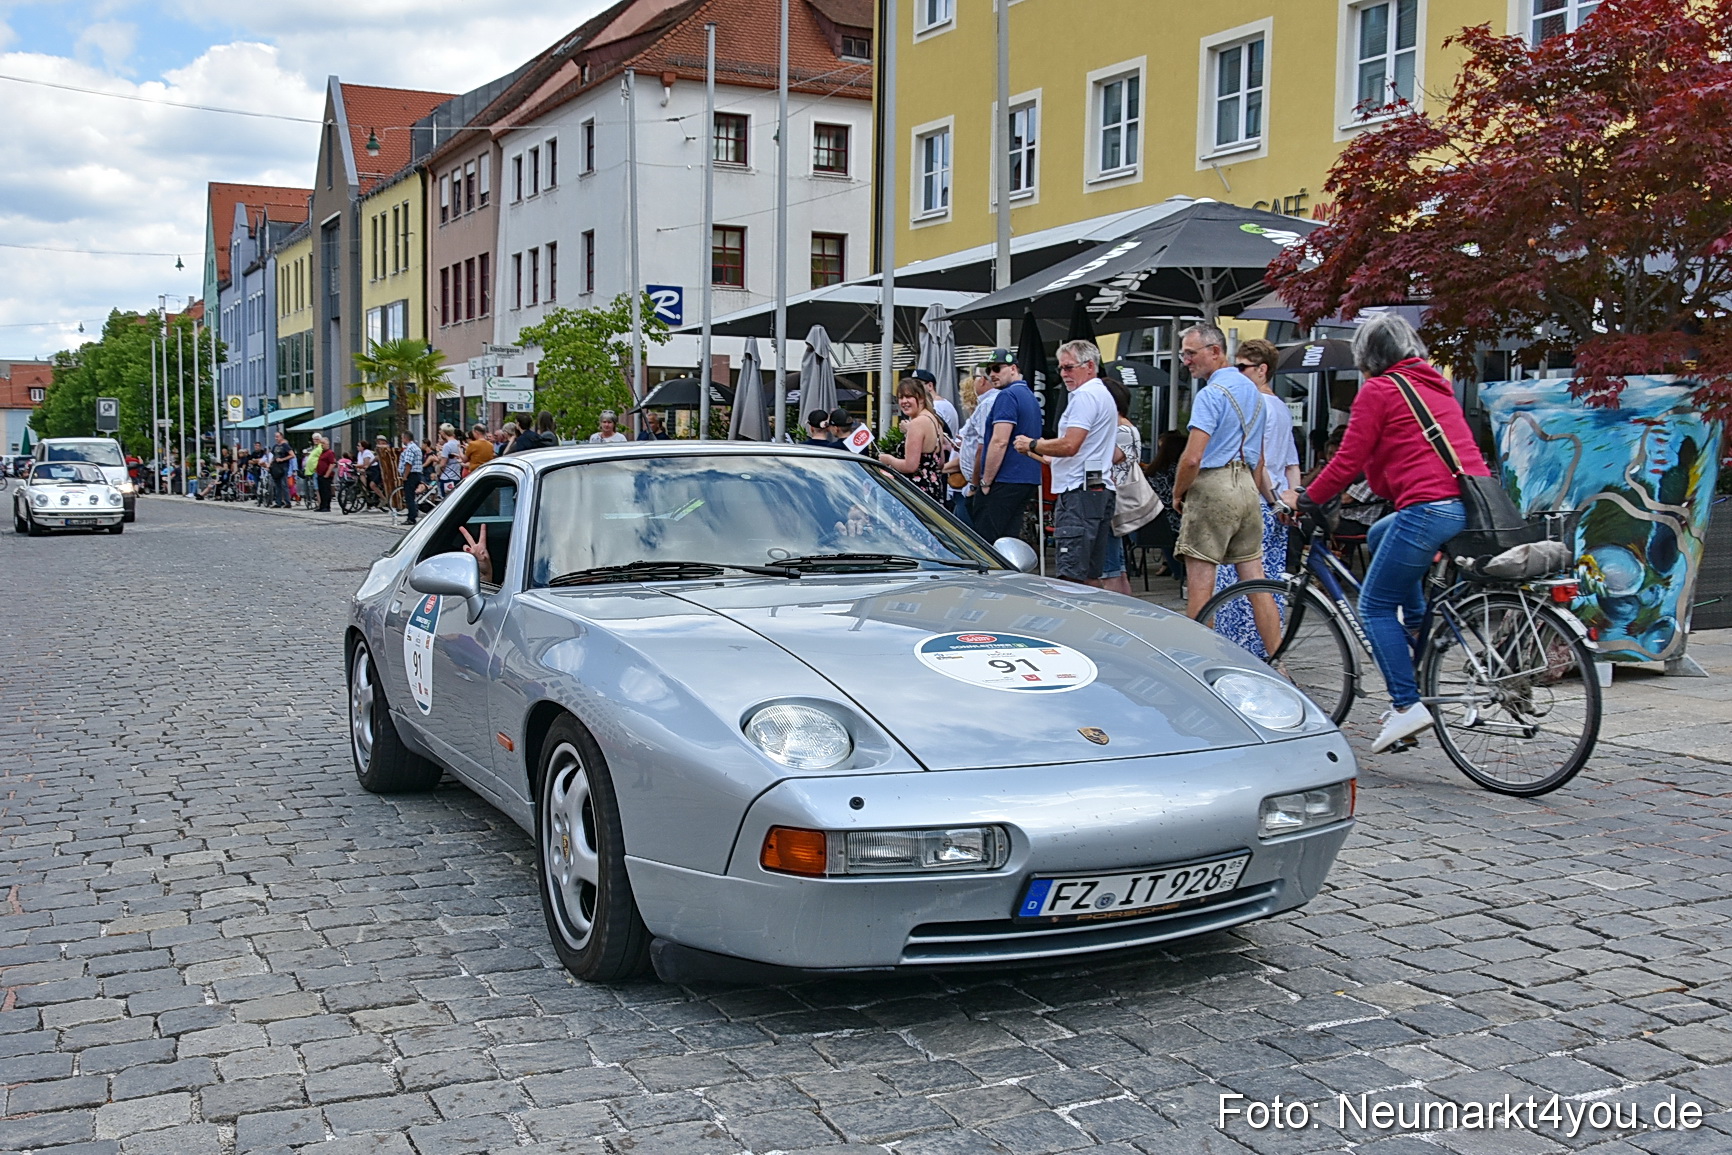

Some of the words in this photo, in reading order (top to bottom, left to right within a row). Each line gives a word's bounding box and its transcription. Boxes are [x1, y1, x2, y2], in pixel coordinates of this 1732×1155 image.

[988, 659, 1041, 674] 91
[1027, 901, 1038, 910] D
[1048, 880, 1100, 911] FZ
[1119, 873, 1166, 906] IT
[1167, 863, 1227, 899] 928
[1077, 902, 1181, 920] PORSCHE
